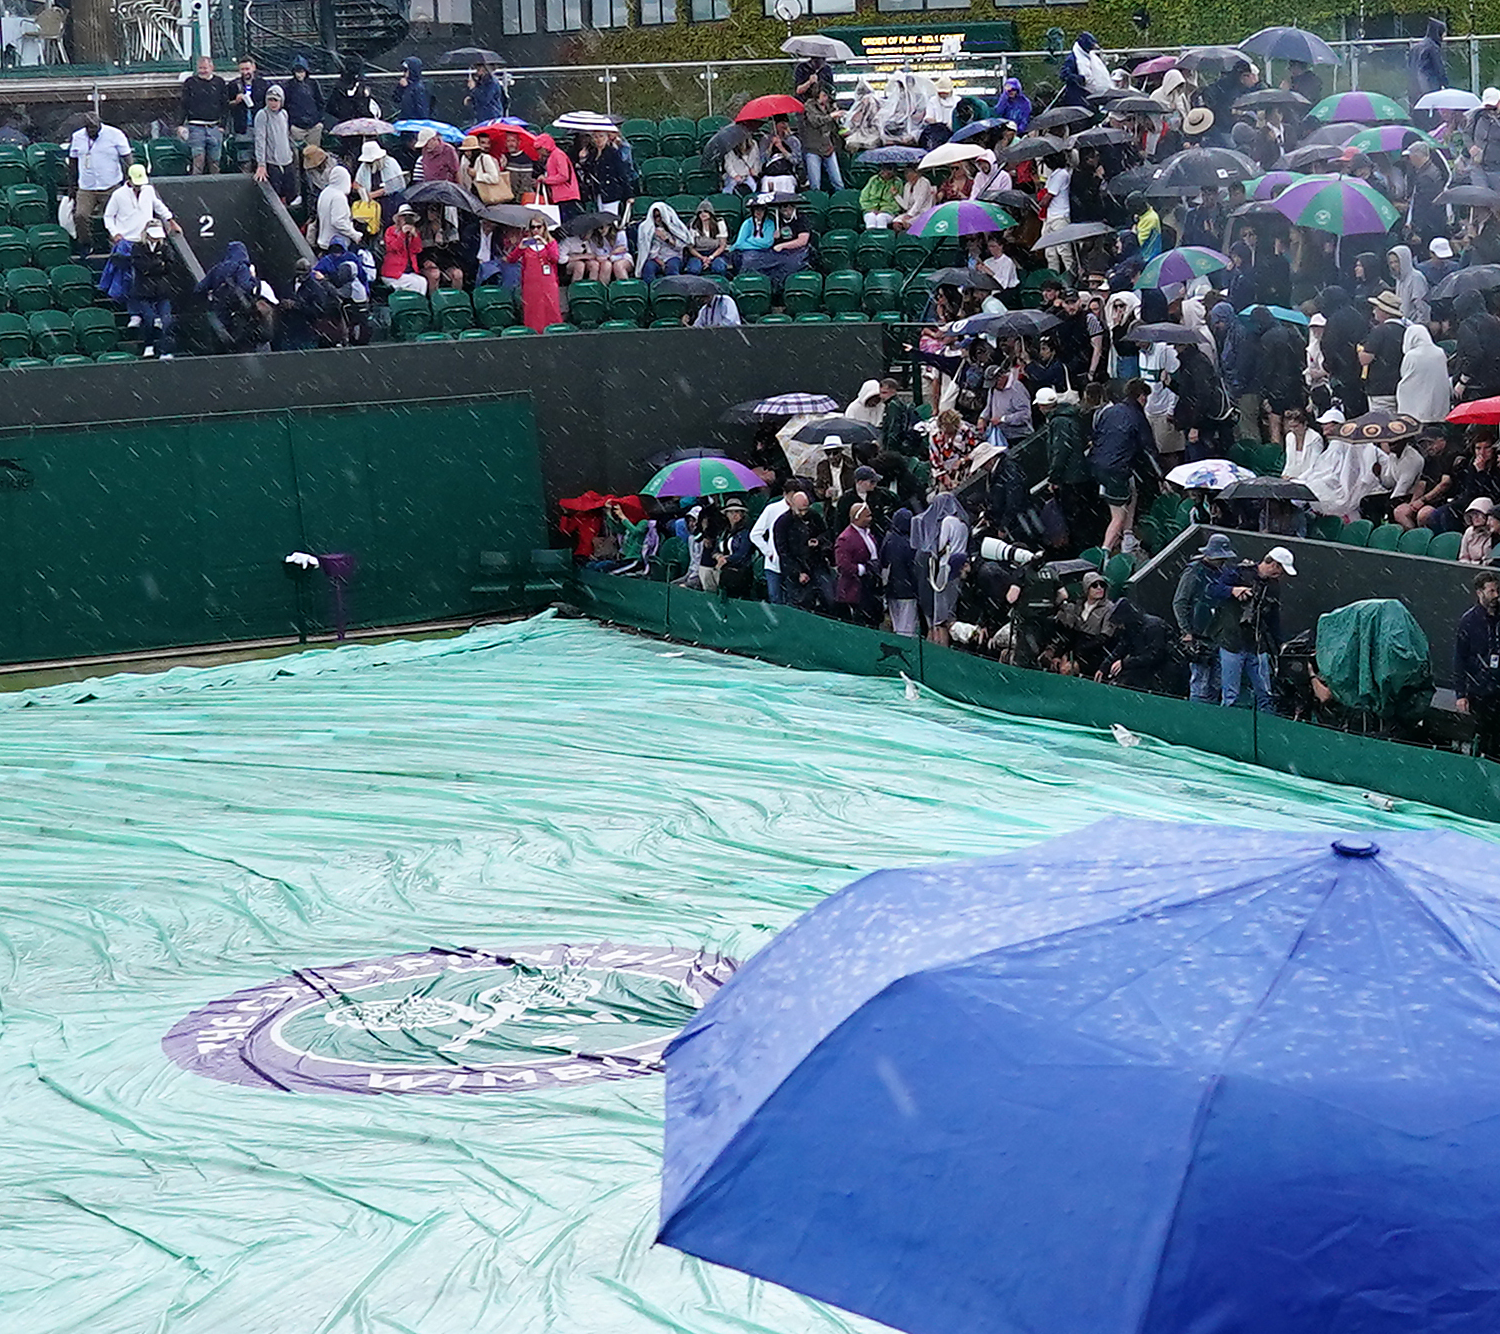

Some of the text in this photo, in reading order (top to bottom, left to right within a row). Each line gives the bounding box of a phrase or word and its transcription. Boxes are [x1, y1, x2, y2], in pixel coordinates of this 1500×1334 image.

[862, 38, 887, 46] ORDER
[888, 37, 898, 45] OF
[899, 36, 917, 44] PLAY
[199, 215, 215, 237] 2
